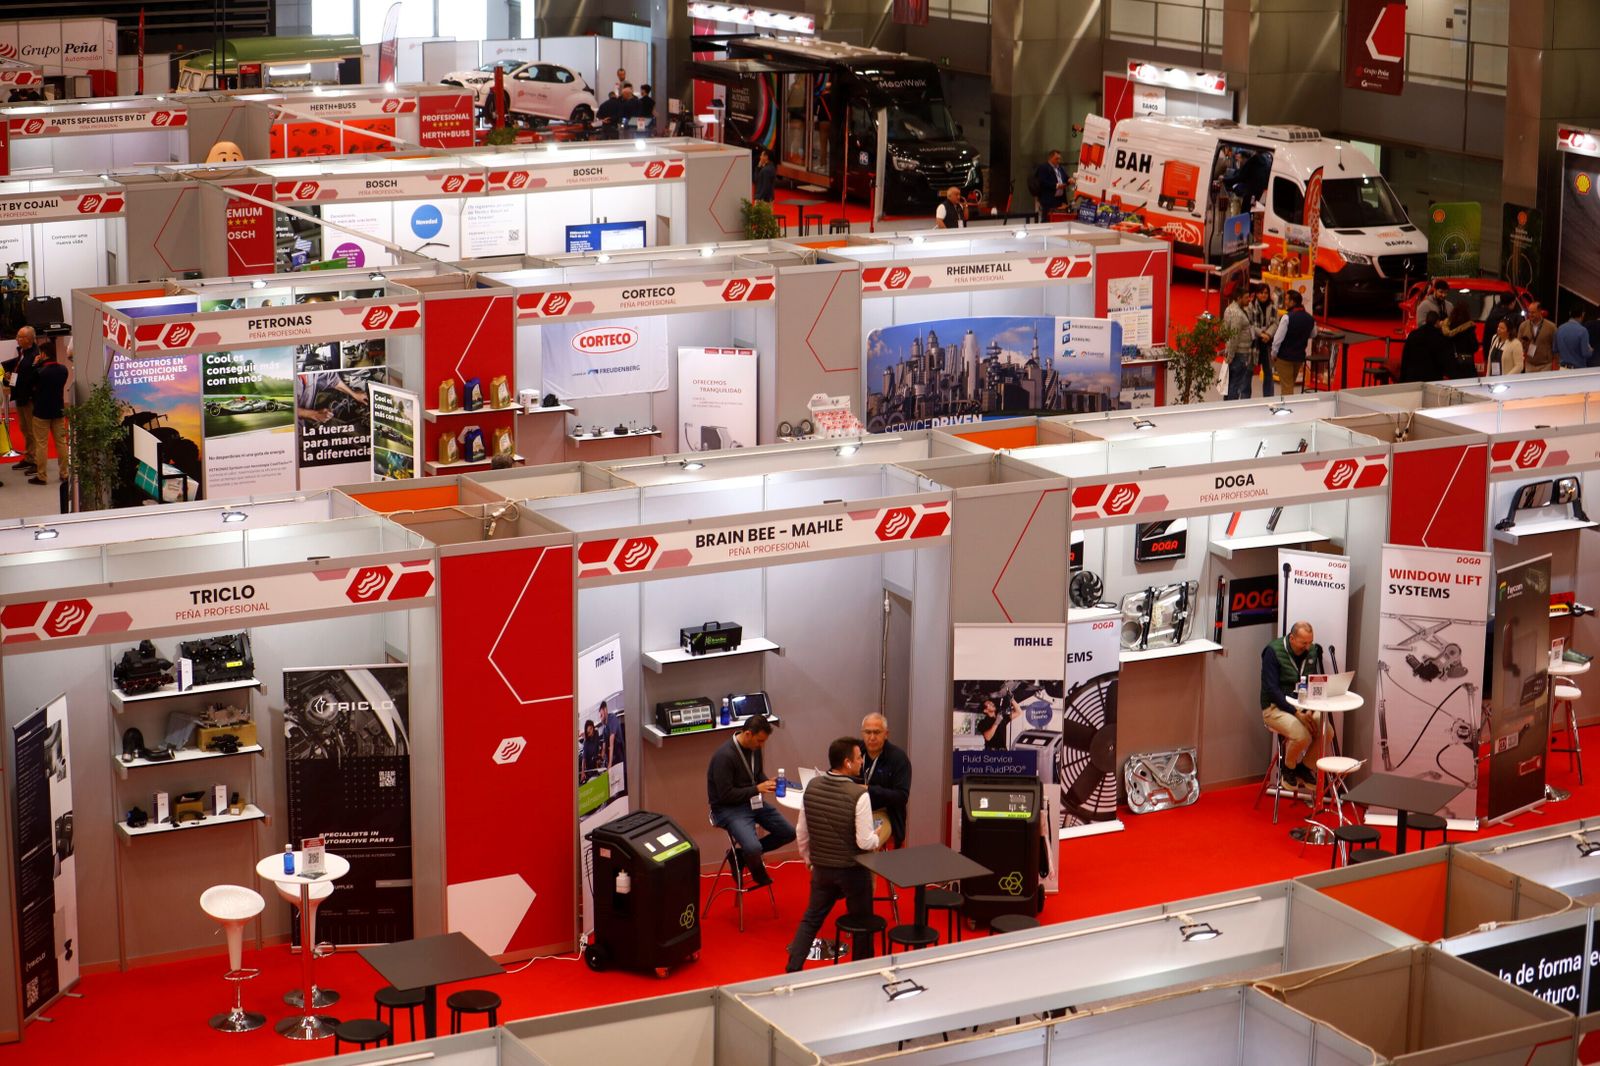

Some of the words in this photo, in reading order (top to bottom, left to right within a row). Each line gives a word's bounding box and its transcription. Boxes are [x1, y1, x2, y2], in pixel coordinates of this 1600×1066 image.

[22, 45, 60, 58] Grupo
[64, 42, 98, 54] Peña
[310, 102, 356, 111] HERTH+BUSS
[51, 117, 76, 126] PARTS
[77, 115, 124, 124] SPECIALISTS
[422, 114, 470, 122] PROFESIONAL
[422, 130, 470, 139] HERTH+BUSS
[573, 168, 603, 176] BOSCH
[366, 180, 397, 188] BOSCH
[10, 202, 22, 211] BY
[24, 200, 58, 209] COJALI
[226, 207, 262, 218] EMIUM
[227, 230, 256, 240] OSCH
[946, 262, 1012, 275] RHEINMETALL
[622, 287, 675, 299] CORTECO
[637, 299, 676, 307] PROFESIONAL
[248, 315, 312, 330] PETRONAS
[268, 328, 312, 338] PROFESIONAL
[580, 333, 631, 348] CORTECO
[126, 358, 171, 369] NOSOTROS
[206, 355, 233, 364] Cool
[130, 366, 187, 376] CONDICIONES
[206, 363, 257, 378] conseguir
[600, 365, 640, 374] FREUDENBERG
[114, 376, 131, 386] MÁS
[133, 374, 175, 384] EXTREMAS
[207, 378, 226, 386] con
[228, 374, 262, 384] menos
[303, 426, 315, 436] La
[318, 423, 355, 435] fuerza
[303, 439, 328, 450] para
[331, 435, 371, 446] marcar
[303, 451, 314, 461] la
[316, 447, 371, 460] diferencia
[1215, 474, 1255, 490] DOGA
[1200, 492, 1219, 502] PEÑA
[1221, 489, 1269, 500] PROFESIONAL
[695, 529, 745, 548] BRAIN
[748, 526, 775, 541] BEE
[791, 519, 843, 537] MAHLE
[728, 546, 751, 557] PEÑA
[753, 541, 810, 554] PROFESIONAL
[1151, 539, 1178, 552] DOGA
[1294, 570, 1333, 580] RESORTES
[1390, 568, 1451, 583] WINDOW
[1455, 574, 1482, 586] LIFT
[1294, 578, 1345, 590] NEUMÁTICOS
[190, 584, 255, 606] TRICLO
[1389, 584, 1450, 599] SYSTEMS
[1231, 589, 1278, 611] DOG
[175, 609, 201, 621] PEÑA
[204, 602, 270, 618] PROFESIONAL
[1092, 622, 1114, 630] DOGA
[1014, 638, 1053, 647] MAHLE
[595, 650, 614, 668] MAHLE
[1067, 651, 1093, 663] EMS
[326, 701, 394, 711] TRICLO
[1516, 963, 1534, 985] de
[1538, 955, 1582, 980] forma
